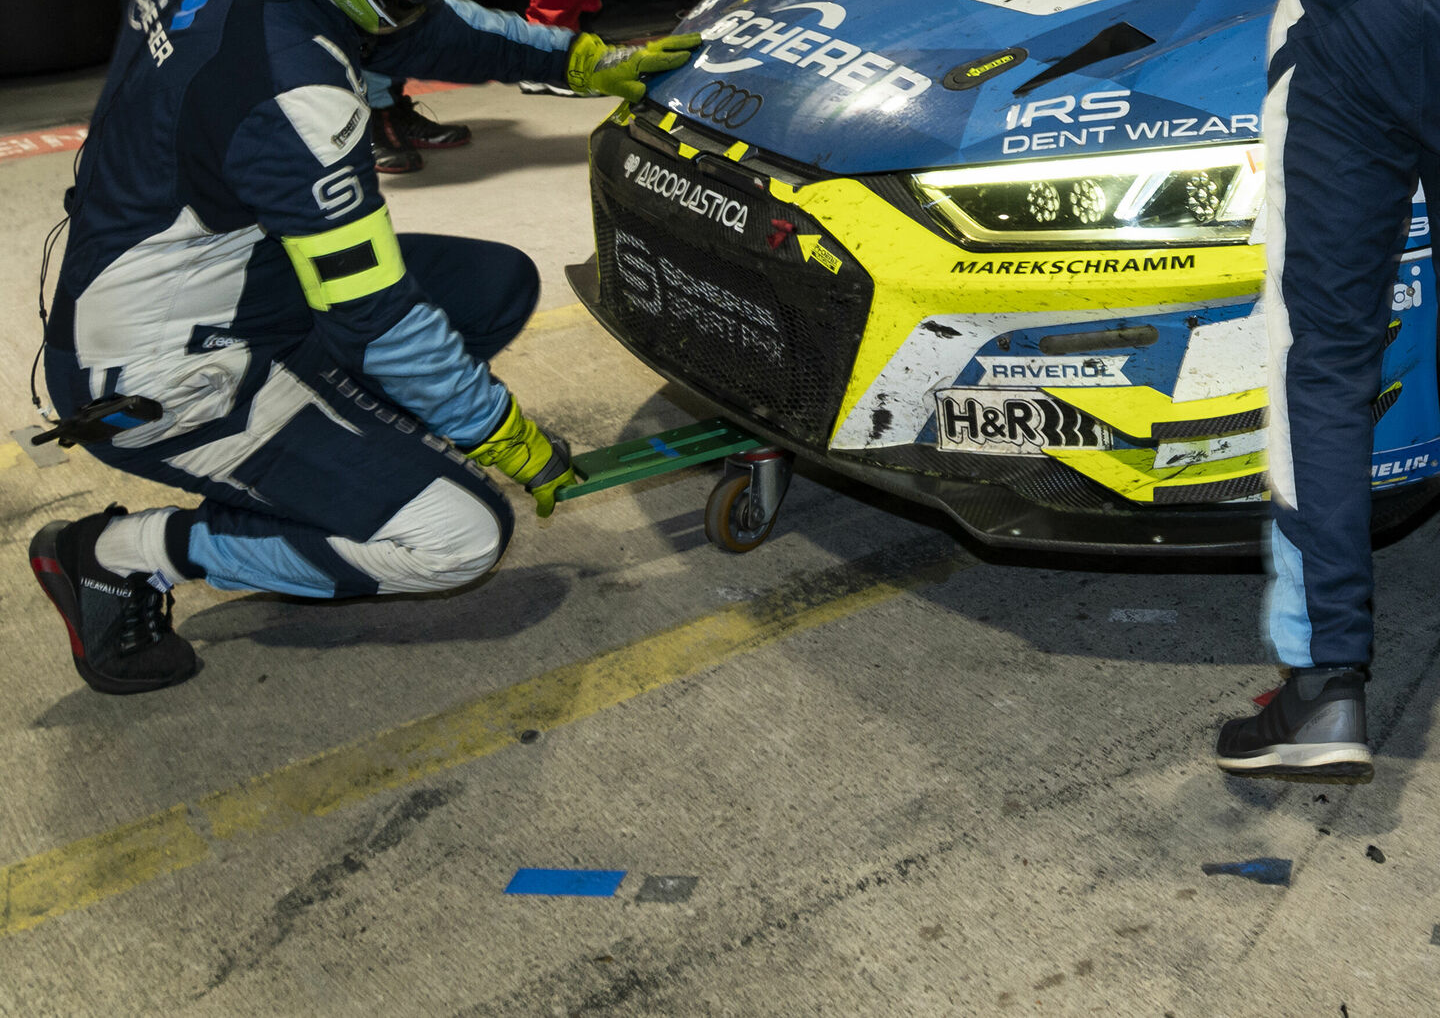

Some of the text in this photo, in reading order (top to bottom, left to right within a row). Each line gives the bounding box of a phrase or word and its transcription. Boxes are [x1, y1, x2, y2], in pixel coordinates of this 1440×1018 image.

[700, 8, 933, 110] SCHERER
[331, 107, 362, 149] freem
[1006, 90, 1131, 130] IRS
[1003, 114, 1265, 155] DENT WIZAR
[635, 162, 749, 234] ARCOPLASTICA
[950, 254, 1196, 275] MAREKSCHRAMM
[202, 333, 244, 349] free
[992, 364, 1116, 379] RAVENOL
[944, 398, 1041, 442] H&R
[1372, 454, 1430, 478] HELIN
